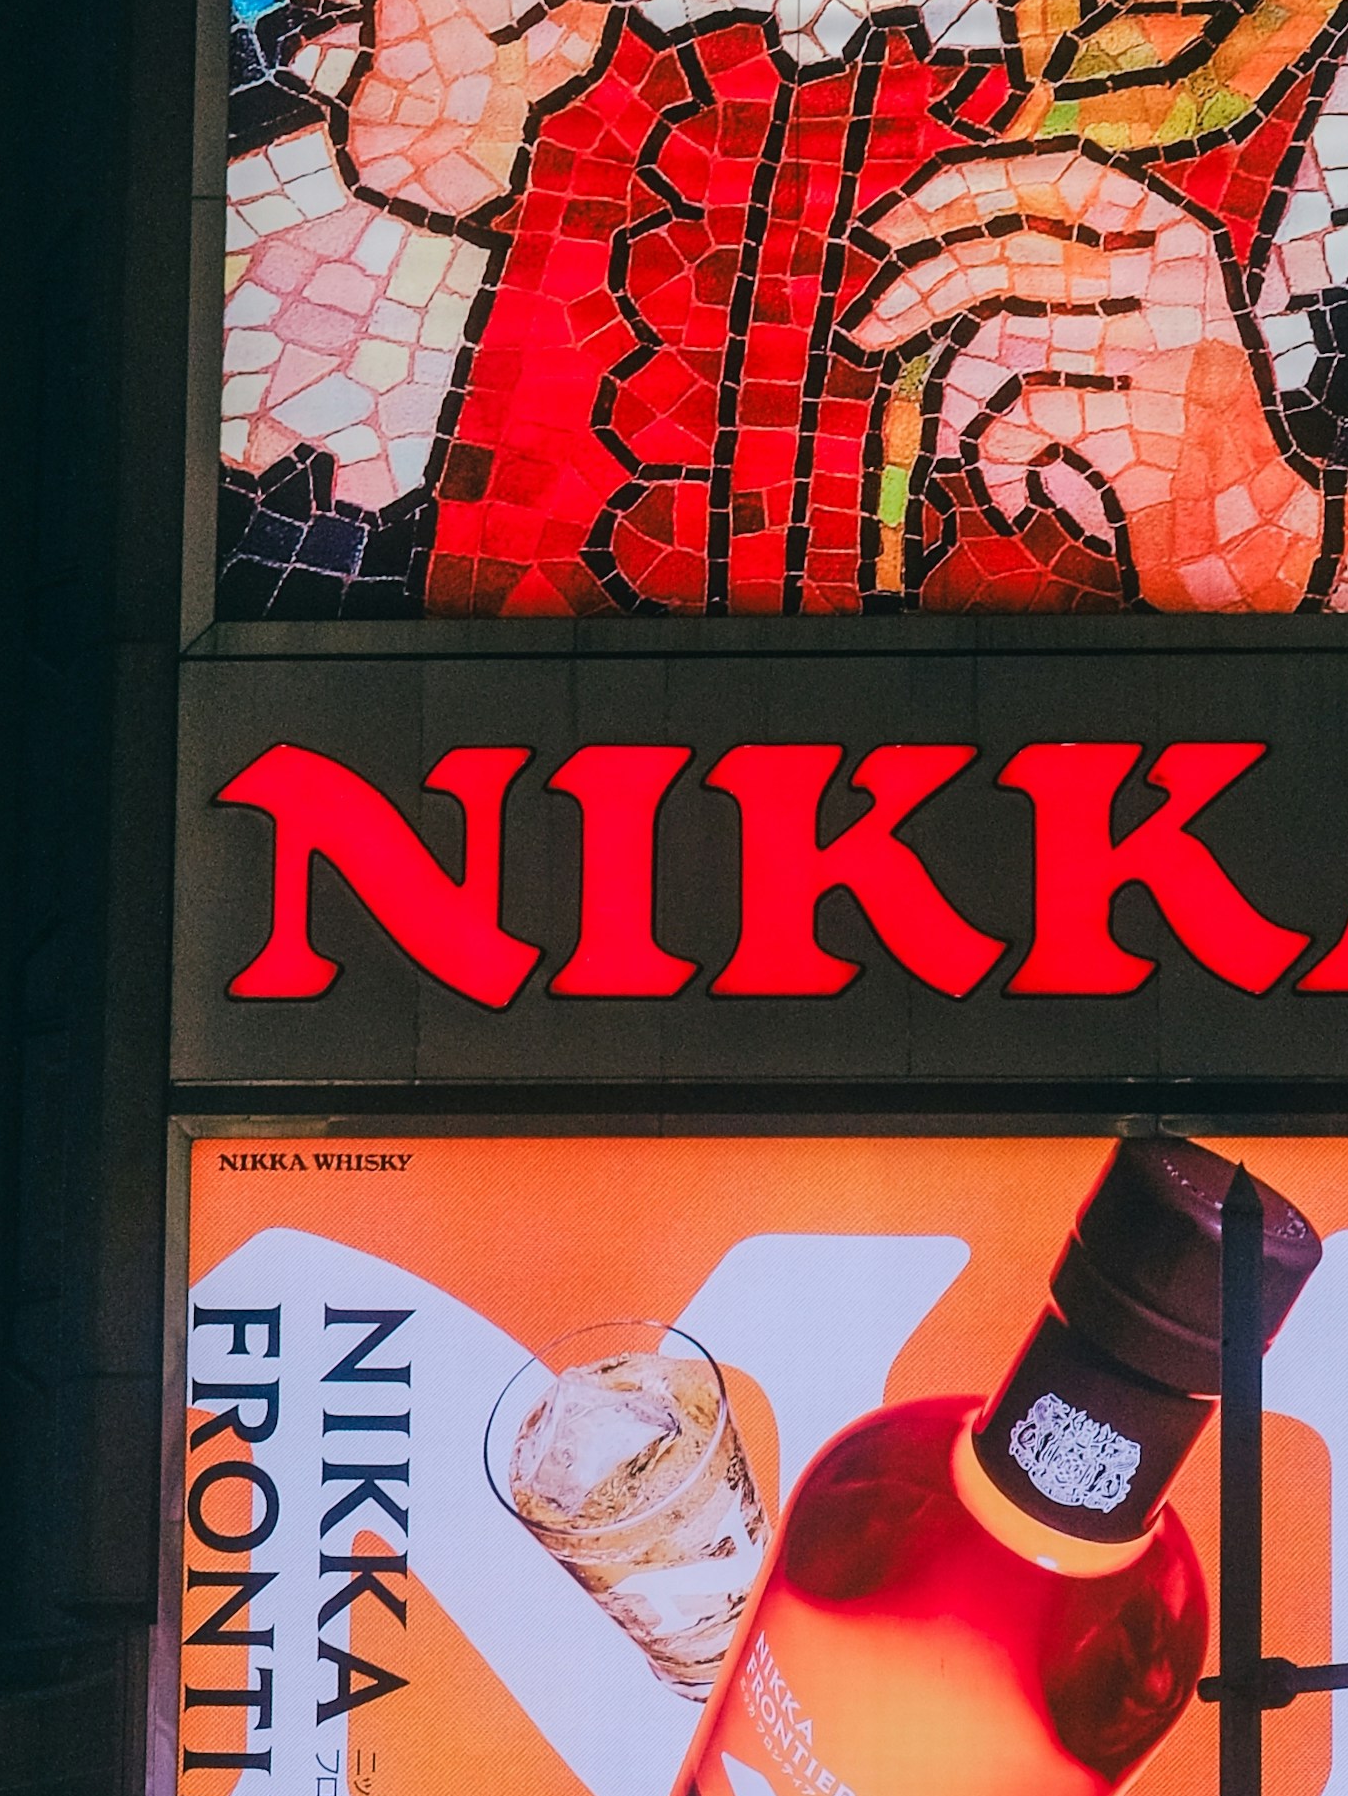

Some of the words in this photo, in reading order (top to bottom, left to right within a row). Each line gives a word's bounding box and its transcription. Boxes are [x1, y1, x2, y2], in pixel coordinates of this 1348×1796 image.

[217, 1153, 309, 1172] NIKKA
[313, 1153, 414, 1173] WHISKY
[313, 1301, 417, 1725] NIKKA
[755, 1630, 815, 1747] NIKKA
